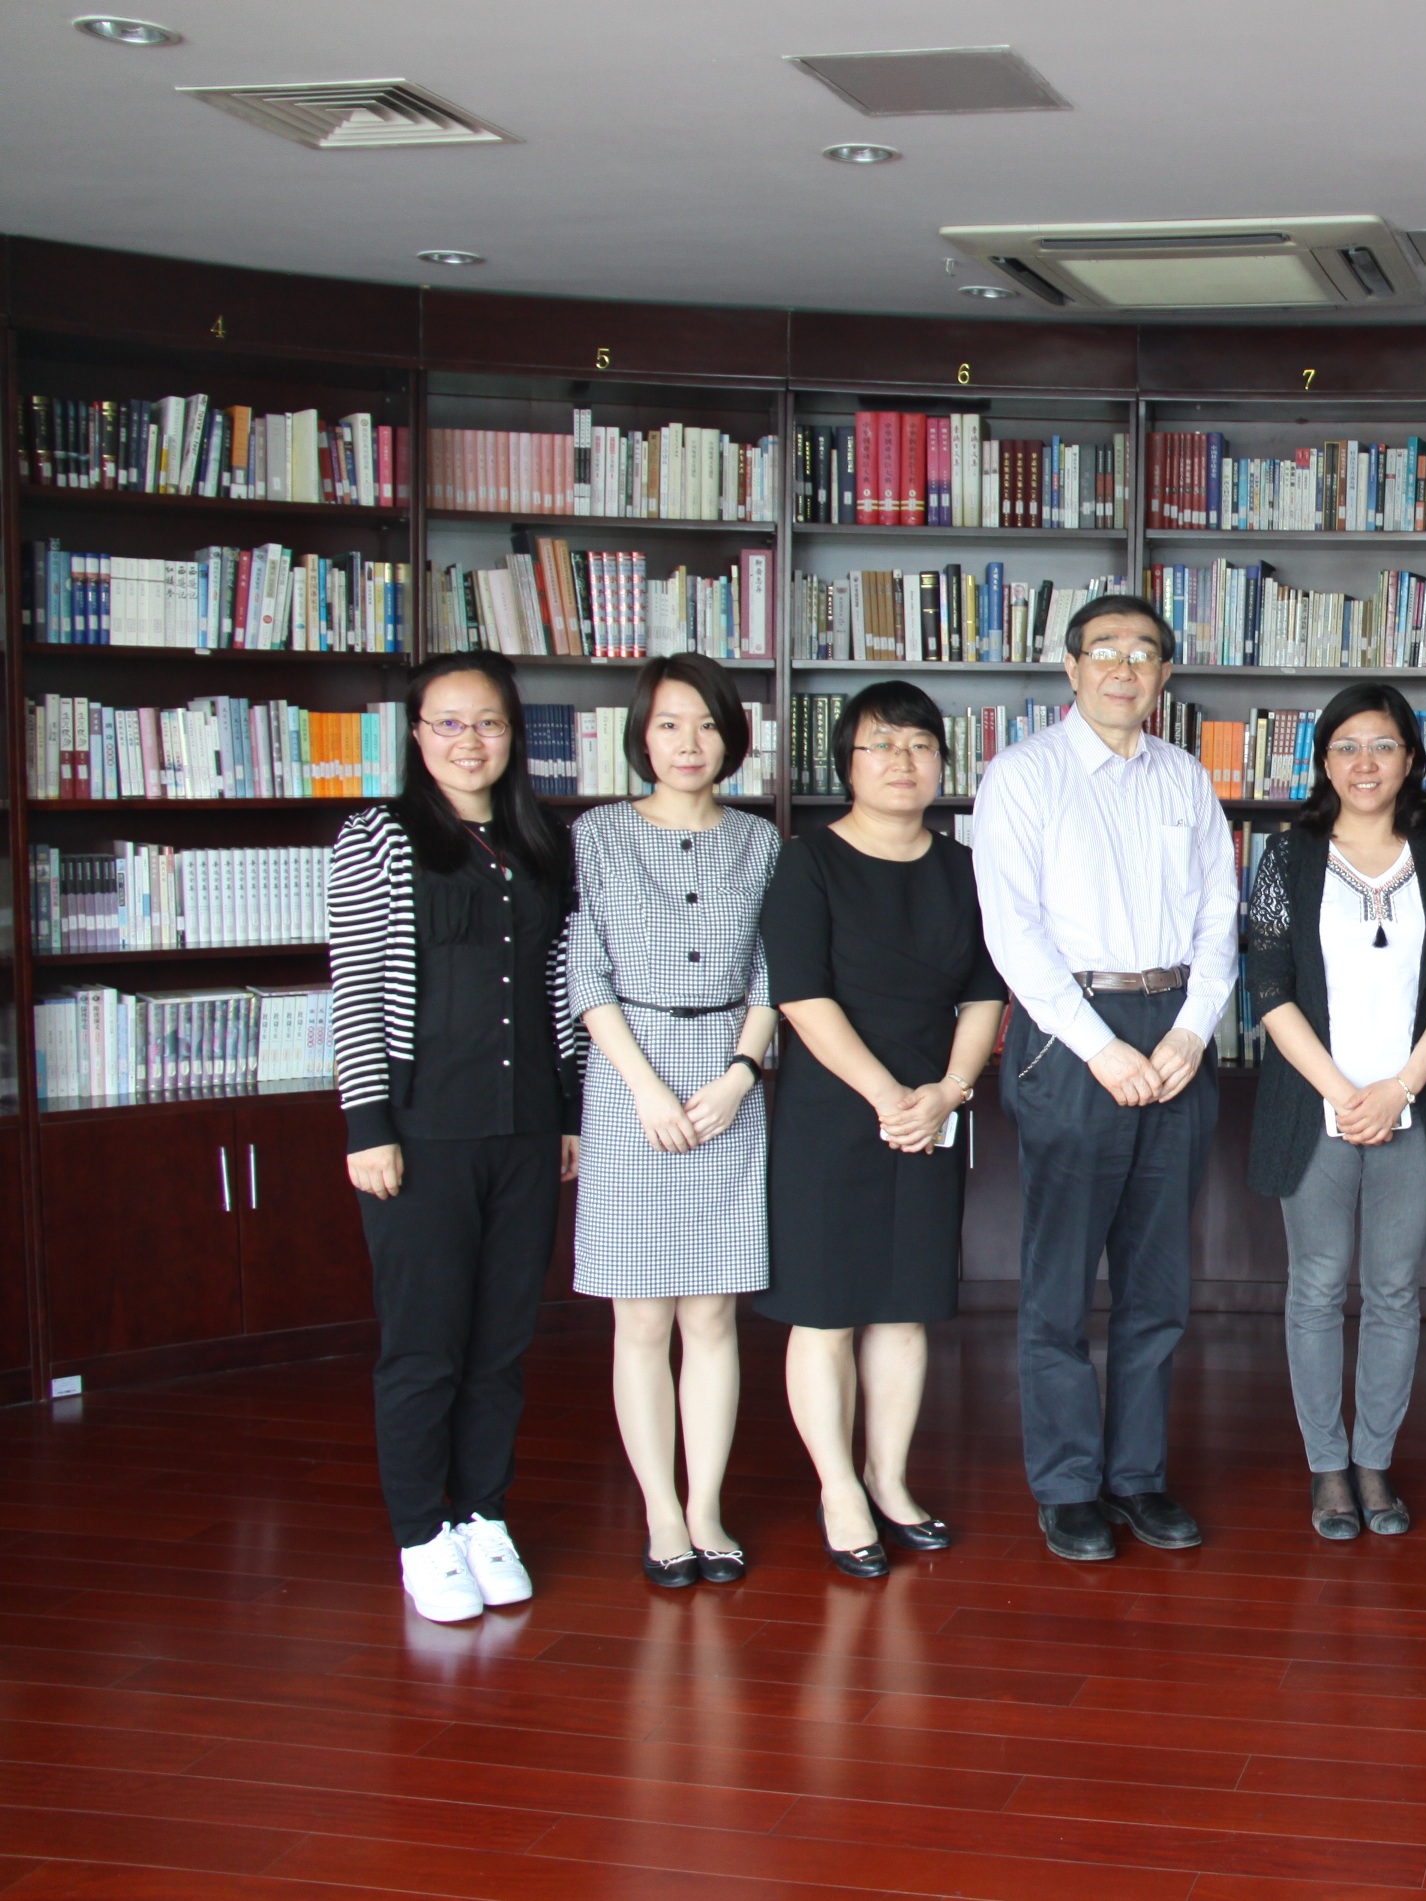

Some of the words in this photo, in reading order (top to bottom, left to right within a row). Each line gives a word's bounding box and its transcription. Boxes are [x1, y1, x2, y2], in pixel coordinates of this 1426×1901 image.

[210, 315, 227, 339] 4
[595, 348, 610, 369] 5
[957, 363, 971, 385] 6
[1302, 369, 1316, 390] 7
